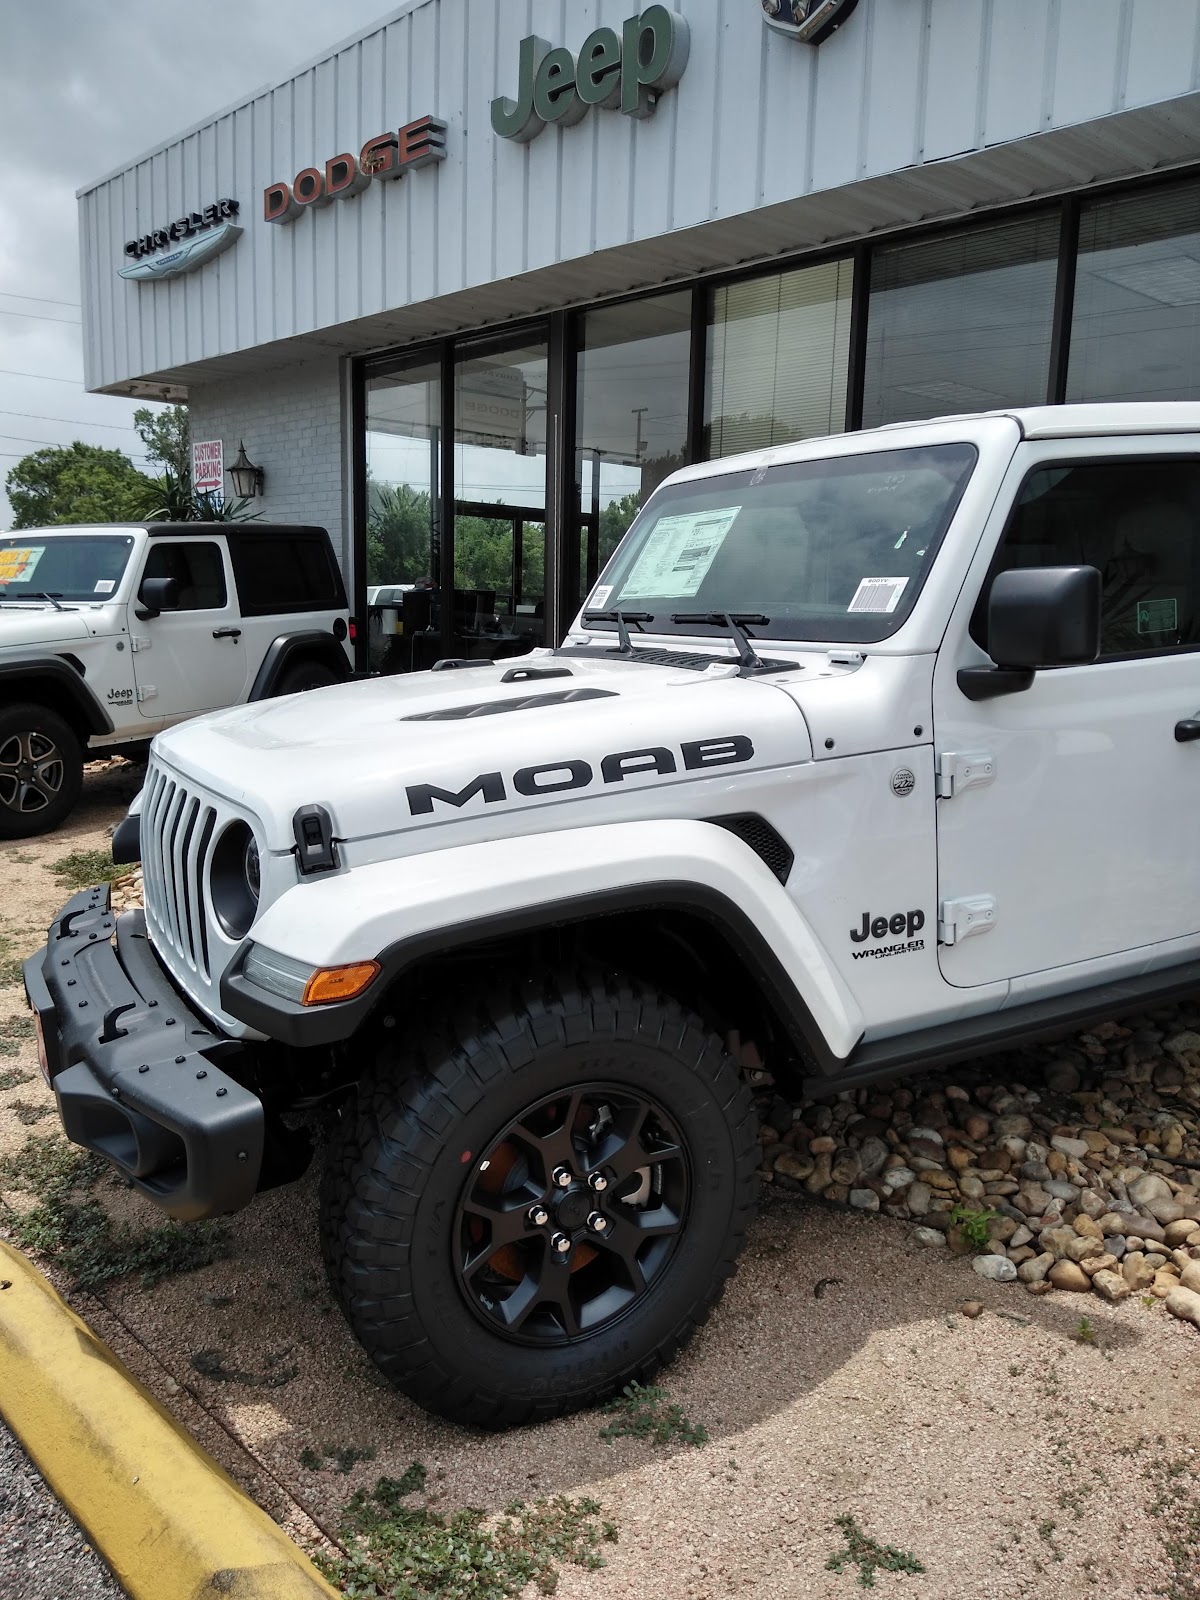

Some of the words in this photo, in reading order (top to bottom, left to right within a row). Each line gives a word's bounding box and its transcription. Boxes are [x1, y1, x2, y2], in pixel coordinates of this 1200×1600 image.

[491, 5, 688, 142] Jeep
[264, 115, 446, 224] DODGE
[124, 198, 239, 259] CHRYSLER
[195, 442, 222, 461] CUSTOMER
[195, 461, 222, 479] PARKING
[107, 688, 133, 699] Jeep
[405, 735, 754, 816] MOAB
[850, 908, 925, 943] Jeep
[852, 939, 924, 960] WRANGLER
[875, 946, 925, 959] UNLIMITED
